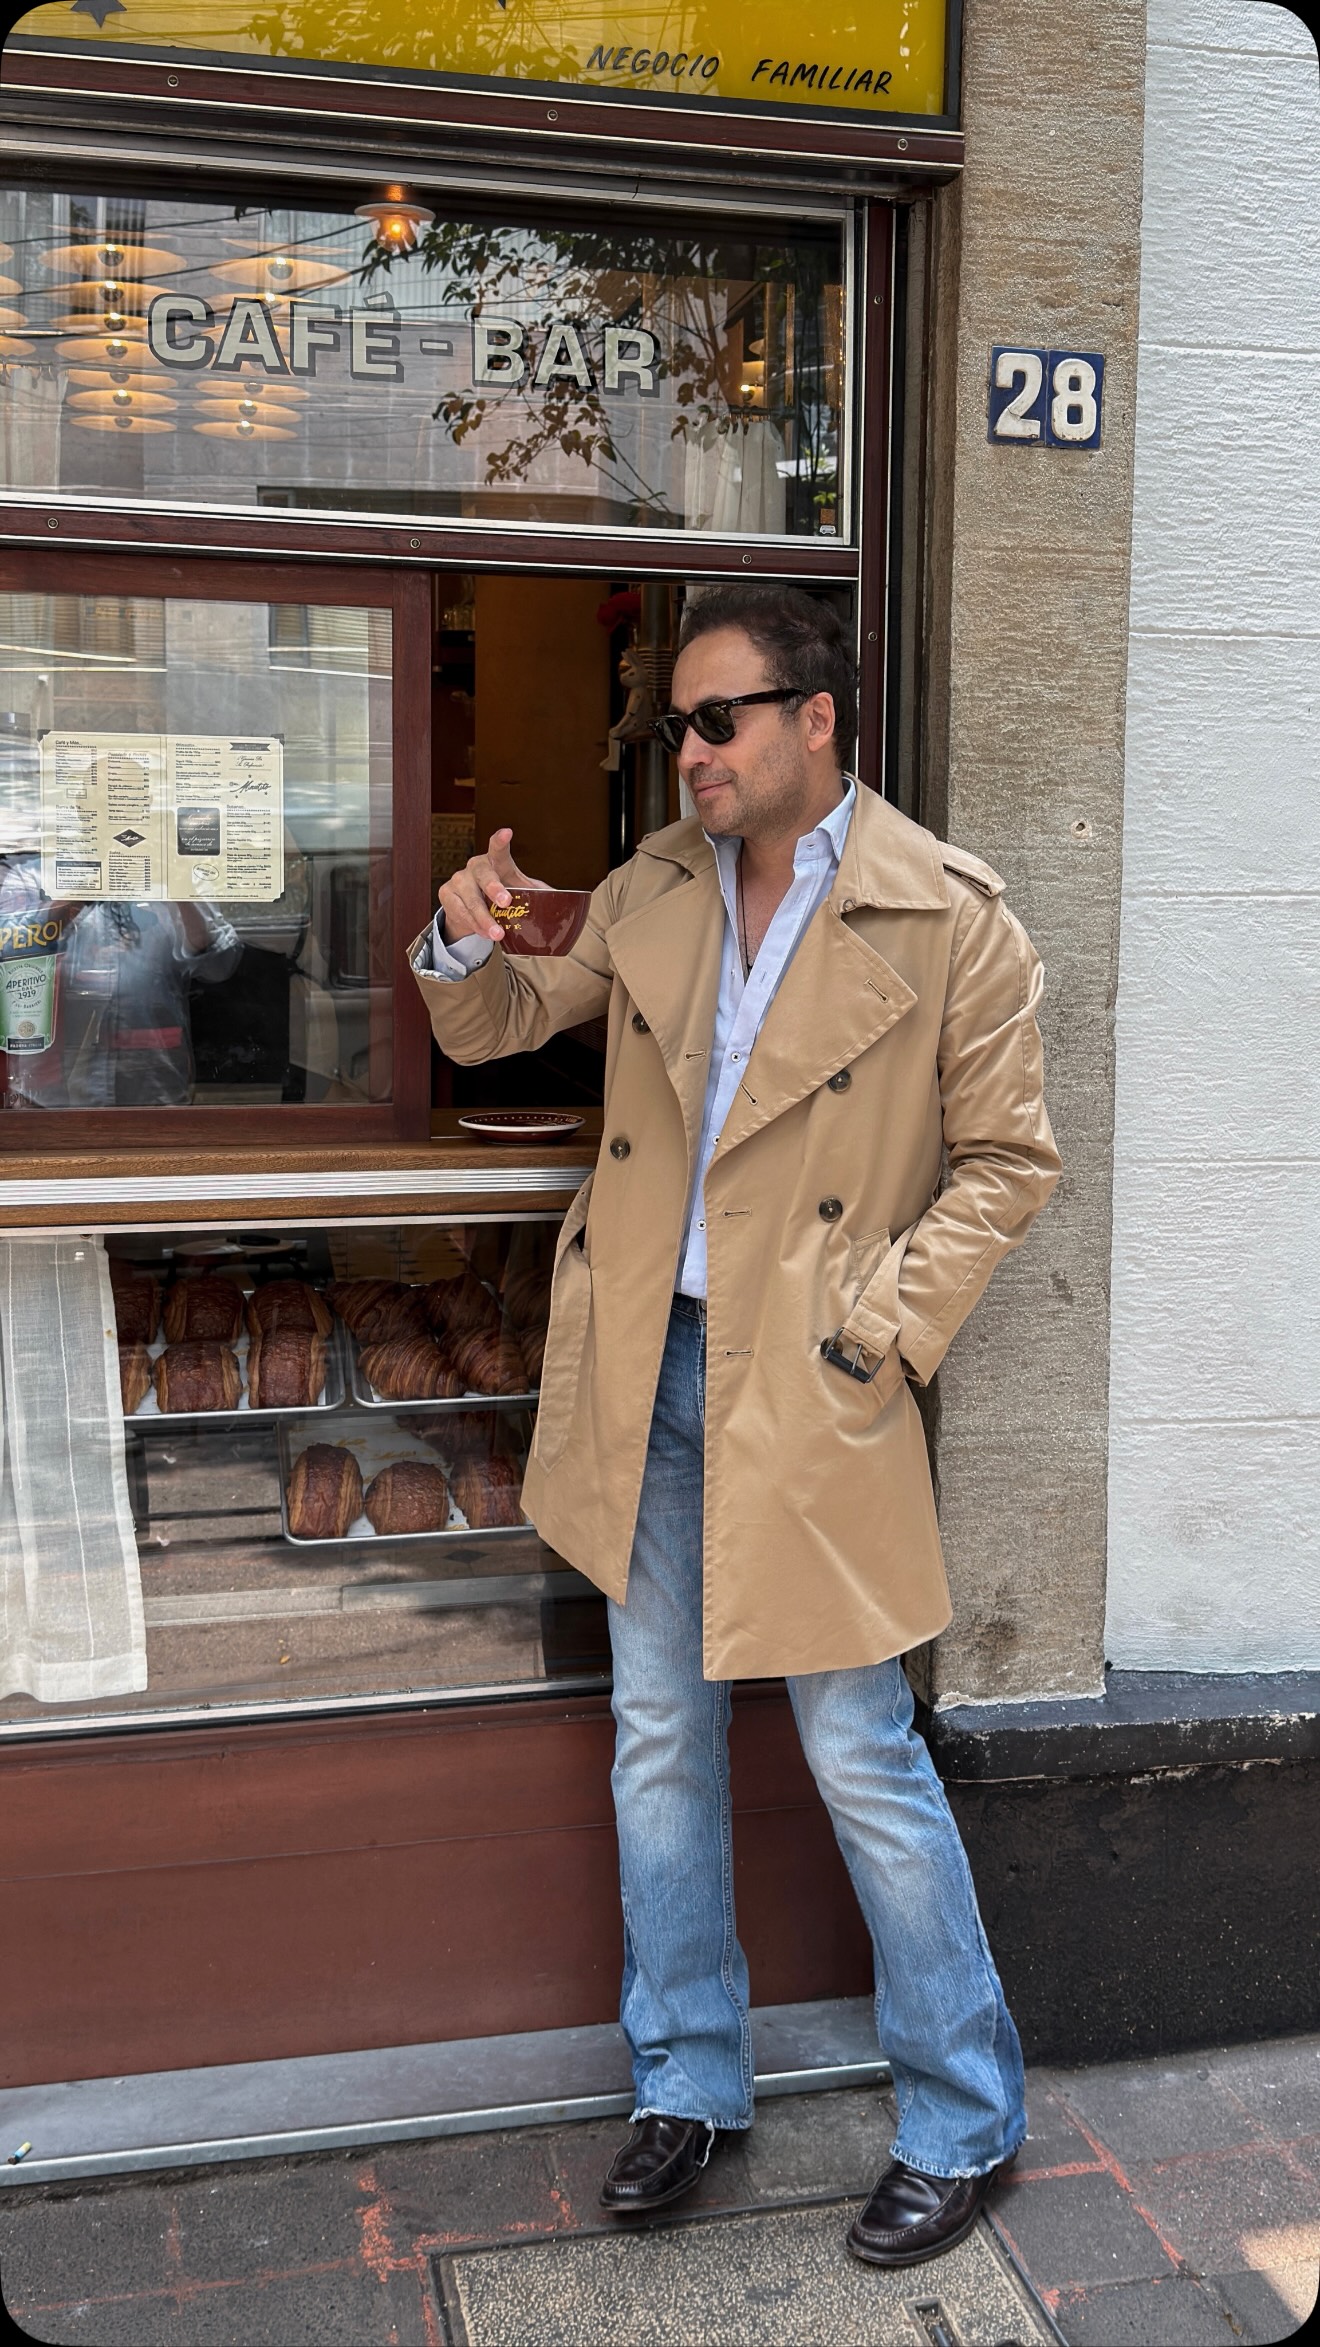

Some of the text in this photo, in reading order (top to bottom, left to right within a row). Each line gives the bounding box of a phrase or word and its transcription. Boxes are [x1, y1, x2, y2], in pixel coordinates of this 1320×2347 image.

[587, 44, 893, 95] NEGOCIO FAMILIAR
[148, 291, 404, 383] CAFÉ
[472, 314, 661, 398] BAR
[993, 352, 1097, 442] 28
[6, 974, 46, 990] APERITIVO
[18, 990, 37, 1000] 1919
